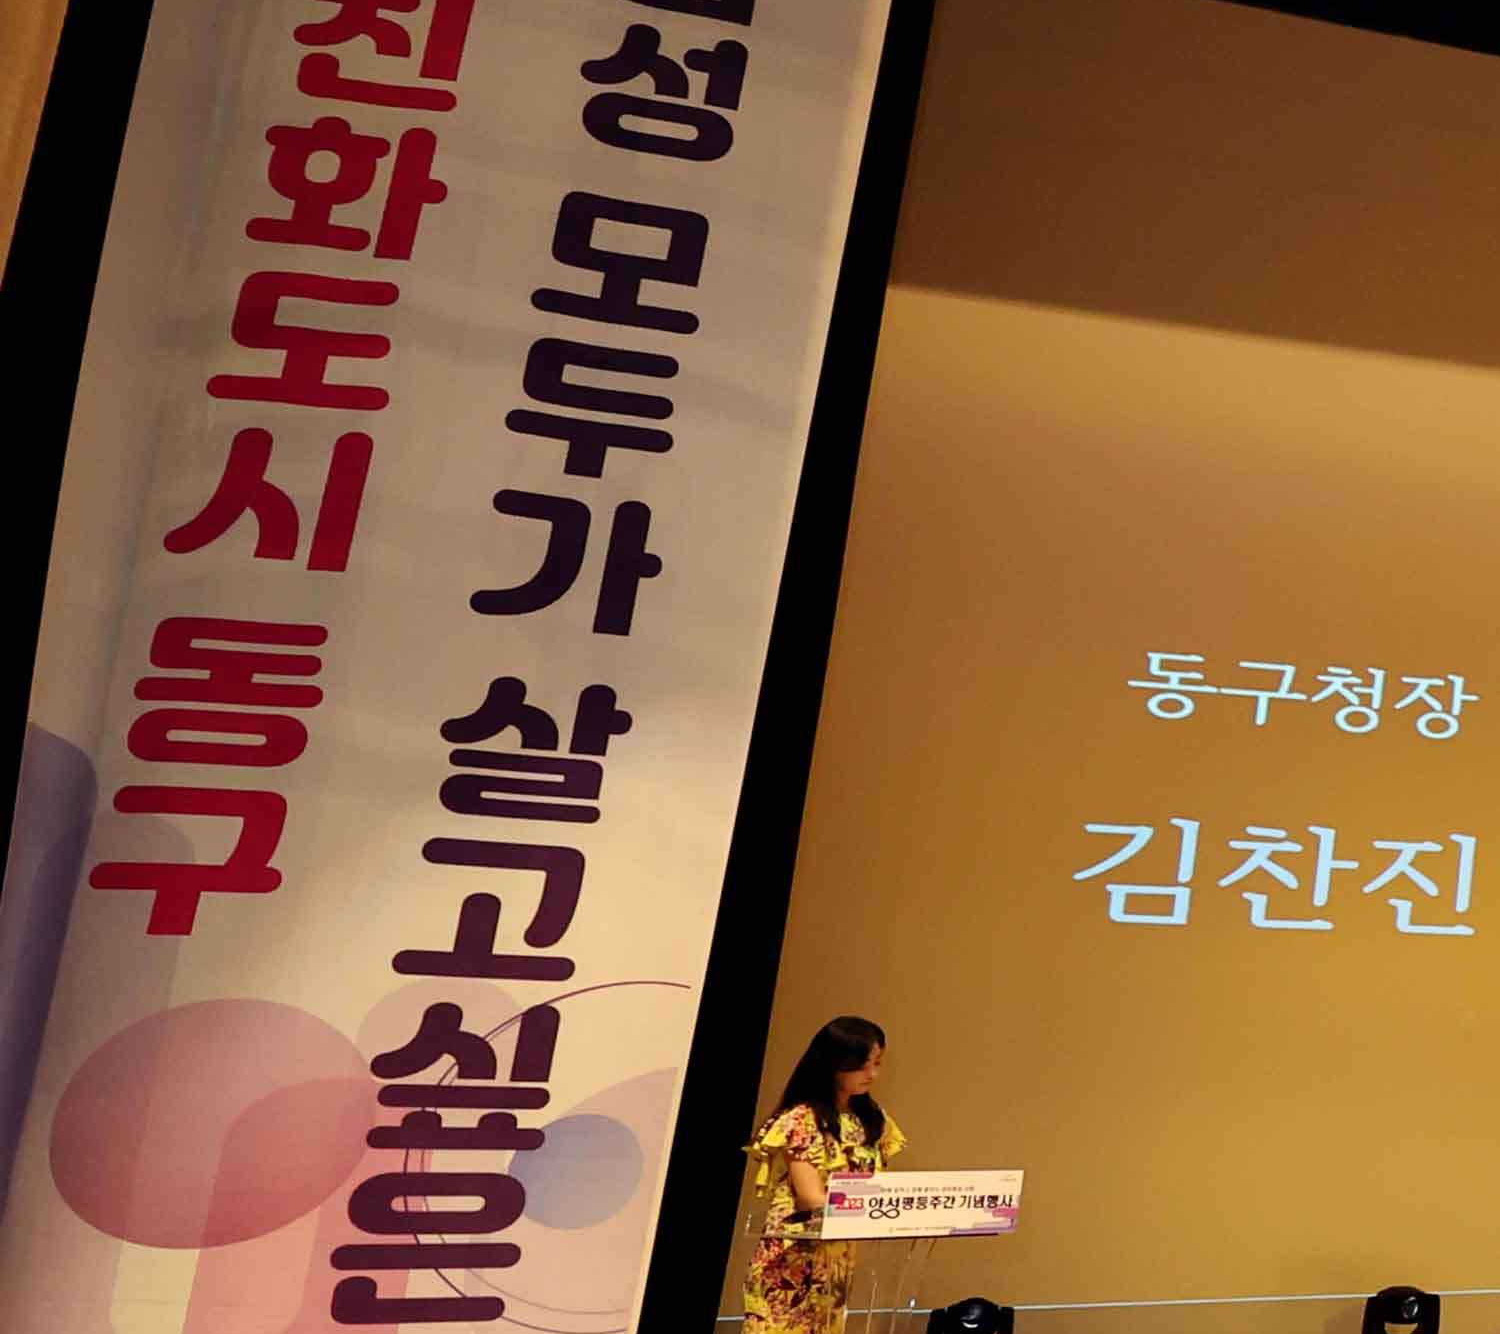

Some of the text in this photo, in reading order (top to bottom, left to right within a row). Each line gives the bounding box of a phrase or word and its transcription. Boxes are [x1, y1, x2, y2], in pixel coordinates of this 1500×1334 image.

[469, 188, 711, 637] 모두가
[89, 616, 329, 935] 동구
[1127, 651, 1480, 740] 동구청장
[1072, 817, 1479, 937] 김찬진
